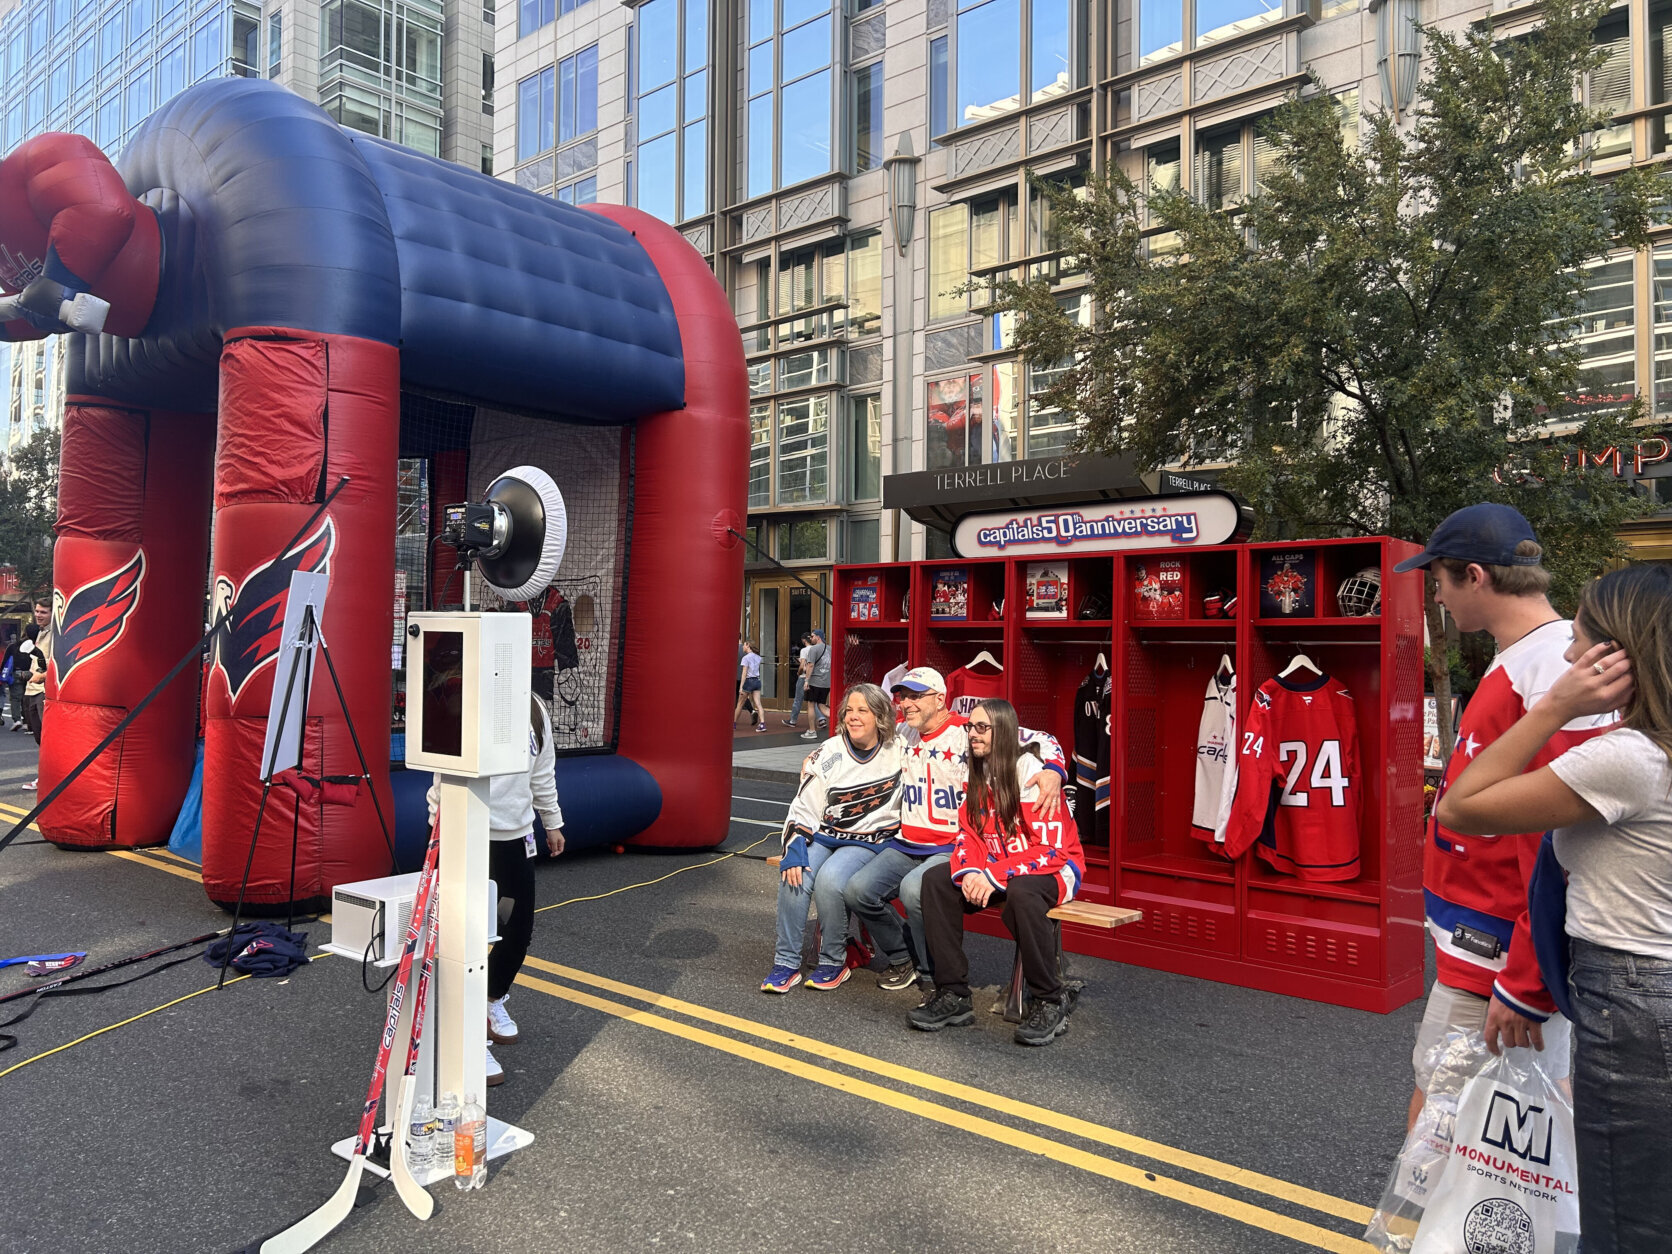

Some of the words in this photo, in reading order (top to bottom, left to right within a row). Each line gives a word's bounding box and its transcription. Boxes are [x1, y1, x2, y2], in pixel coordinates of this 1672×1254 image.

[933, 467, 1006, 491] TERRELL
[1011, 460, 1072, 483] PLACE
[1168, 475, 1193, 490] TERRELL
[1193, 480, 1212, 492] PLACE
[979, 518, 1043, 546] capitals
[1075, 511, 1197, 539] anniversary
[1159, 571, 1181, 581] RED
[1242, 731, 1265, 759] 24
[1279, 739, 1350, 808] 24
[1031, 821, 1063, 849] 77
[383, 981, 405, 1050] capitals
[1455, 1143, 1574, 1195] MONUMENTAL
[1466, 1163, 1508, 1186] SPORTS
[1509, 1180, 1558, 1204] NETWORK
